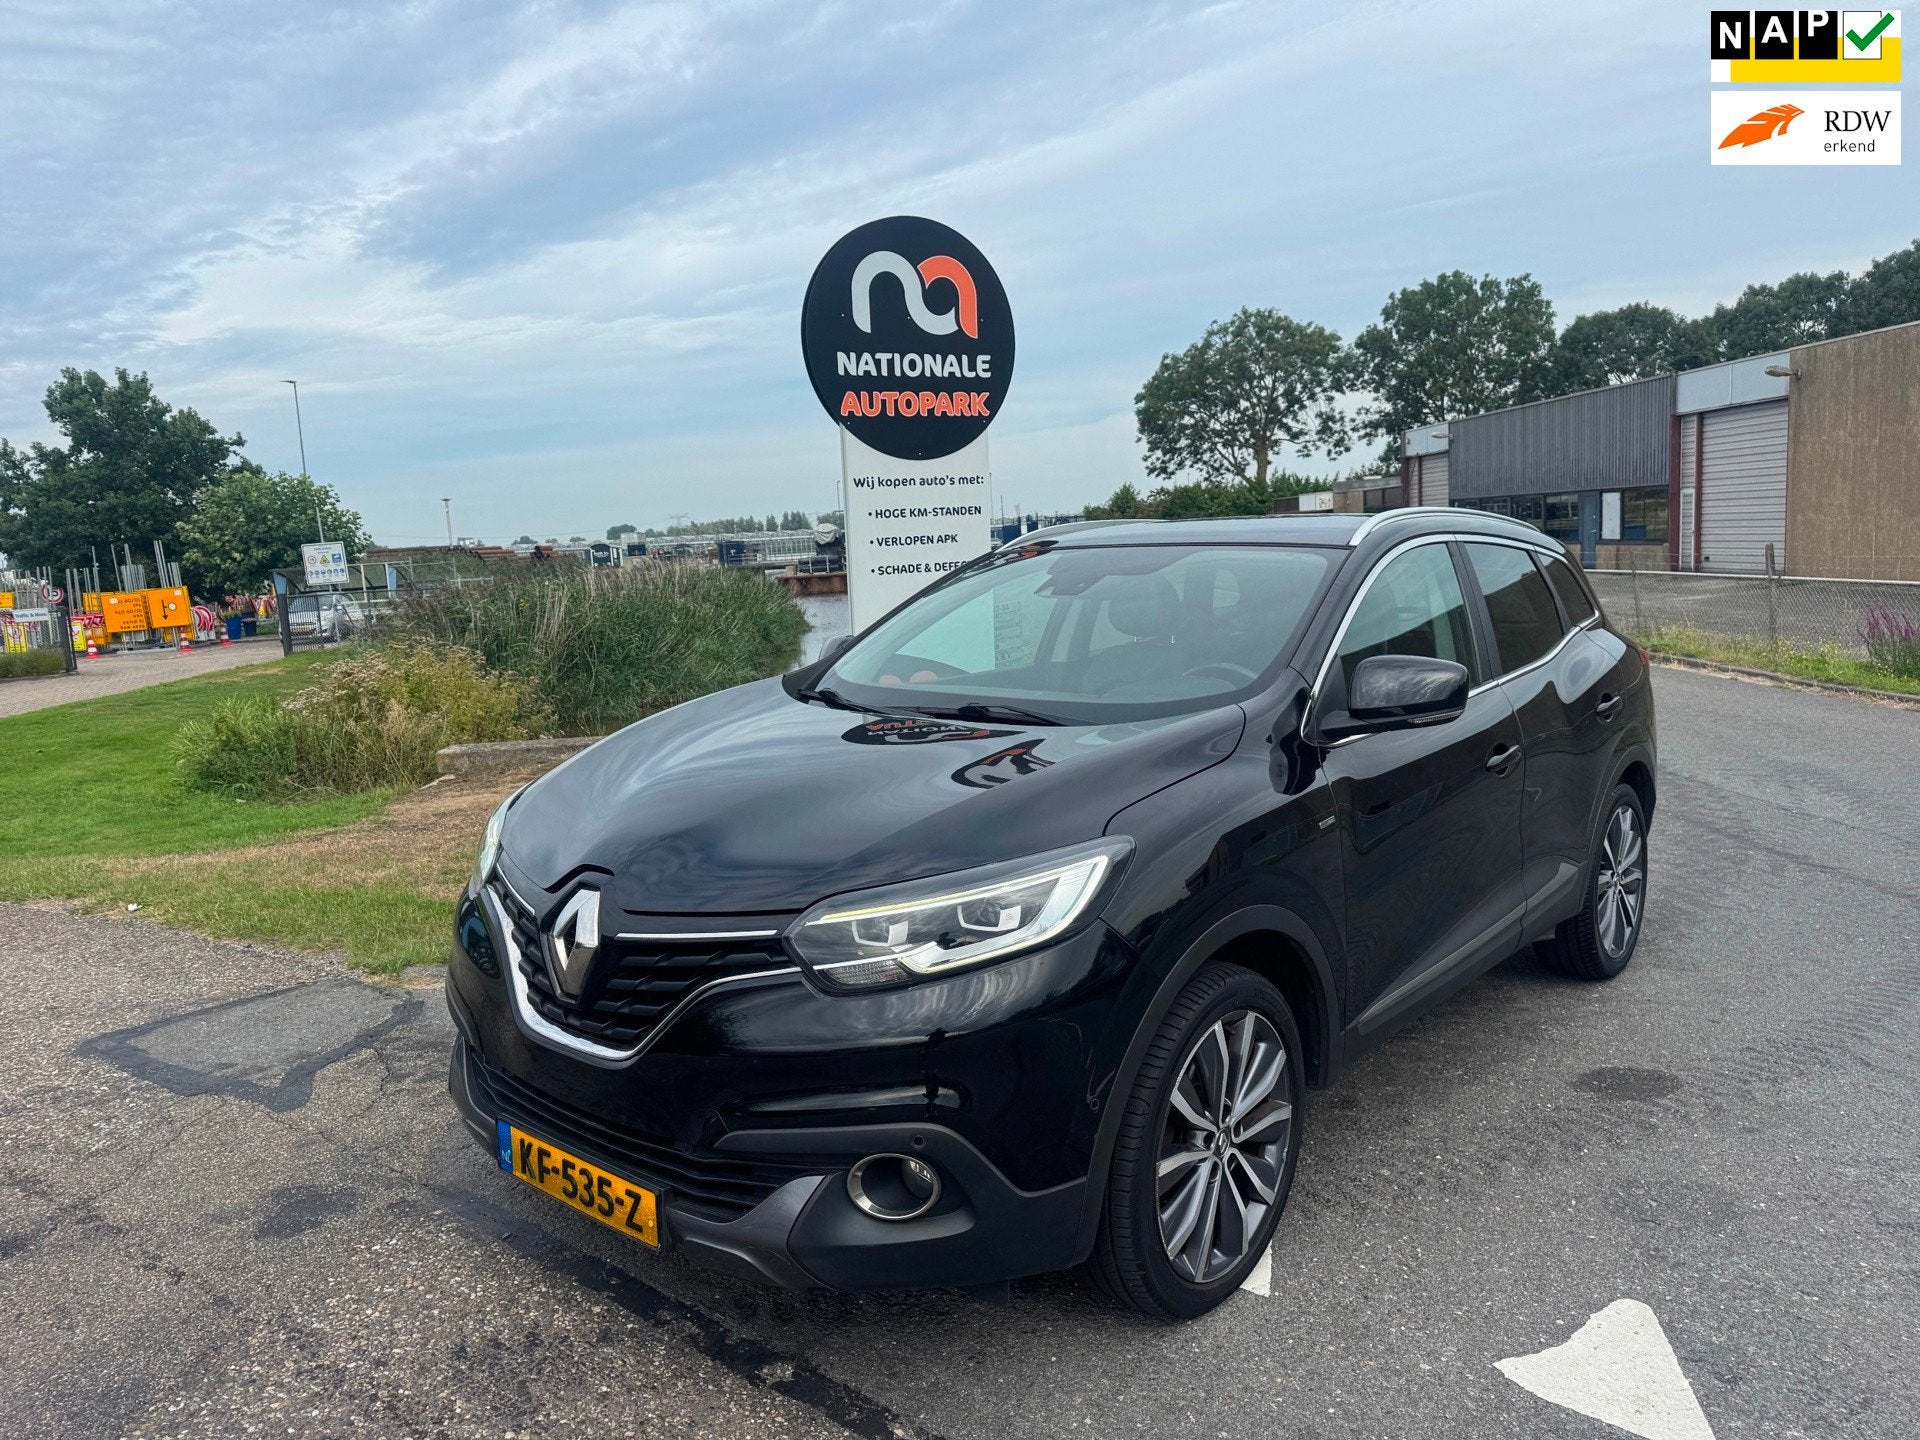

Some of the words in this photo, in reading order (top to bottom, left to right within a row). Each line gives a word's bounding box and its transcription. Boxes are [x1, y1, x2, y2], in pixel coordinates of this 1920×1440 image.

[836, 351, 992, 379] NATIONALE
[840, 391, 991, 417] AUTOPARK
[853, 476, 875, 489] Wij
[877, 476, 916, 489] kopen
[919, 475, 955, 486] auto's
[958, 474, 984, 485] met:
[875, 508, 907, 519] HOGE
[909, 505, 982, 518] KM-STANDEN
[876, 535, 934, 547] VERLOPEN
[936, 533, 959, 544] APK
[877, 564, 922, 576] SCHADE
[924, 563, 932, 573] &
[519, 1137, 643, 1233] KF-535-Z
